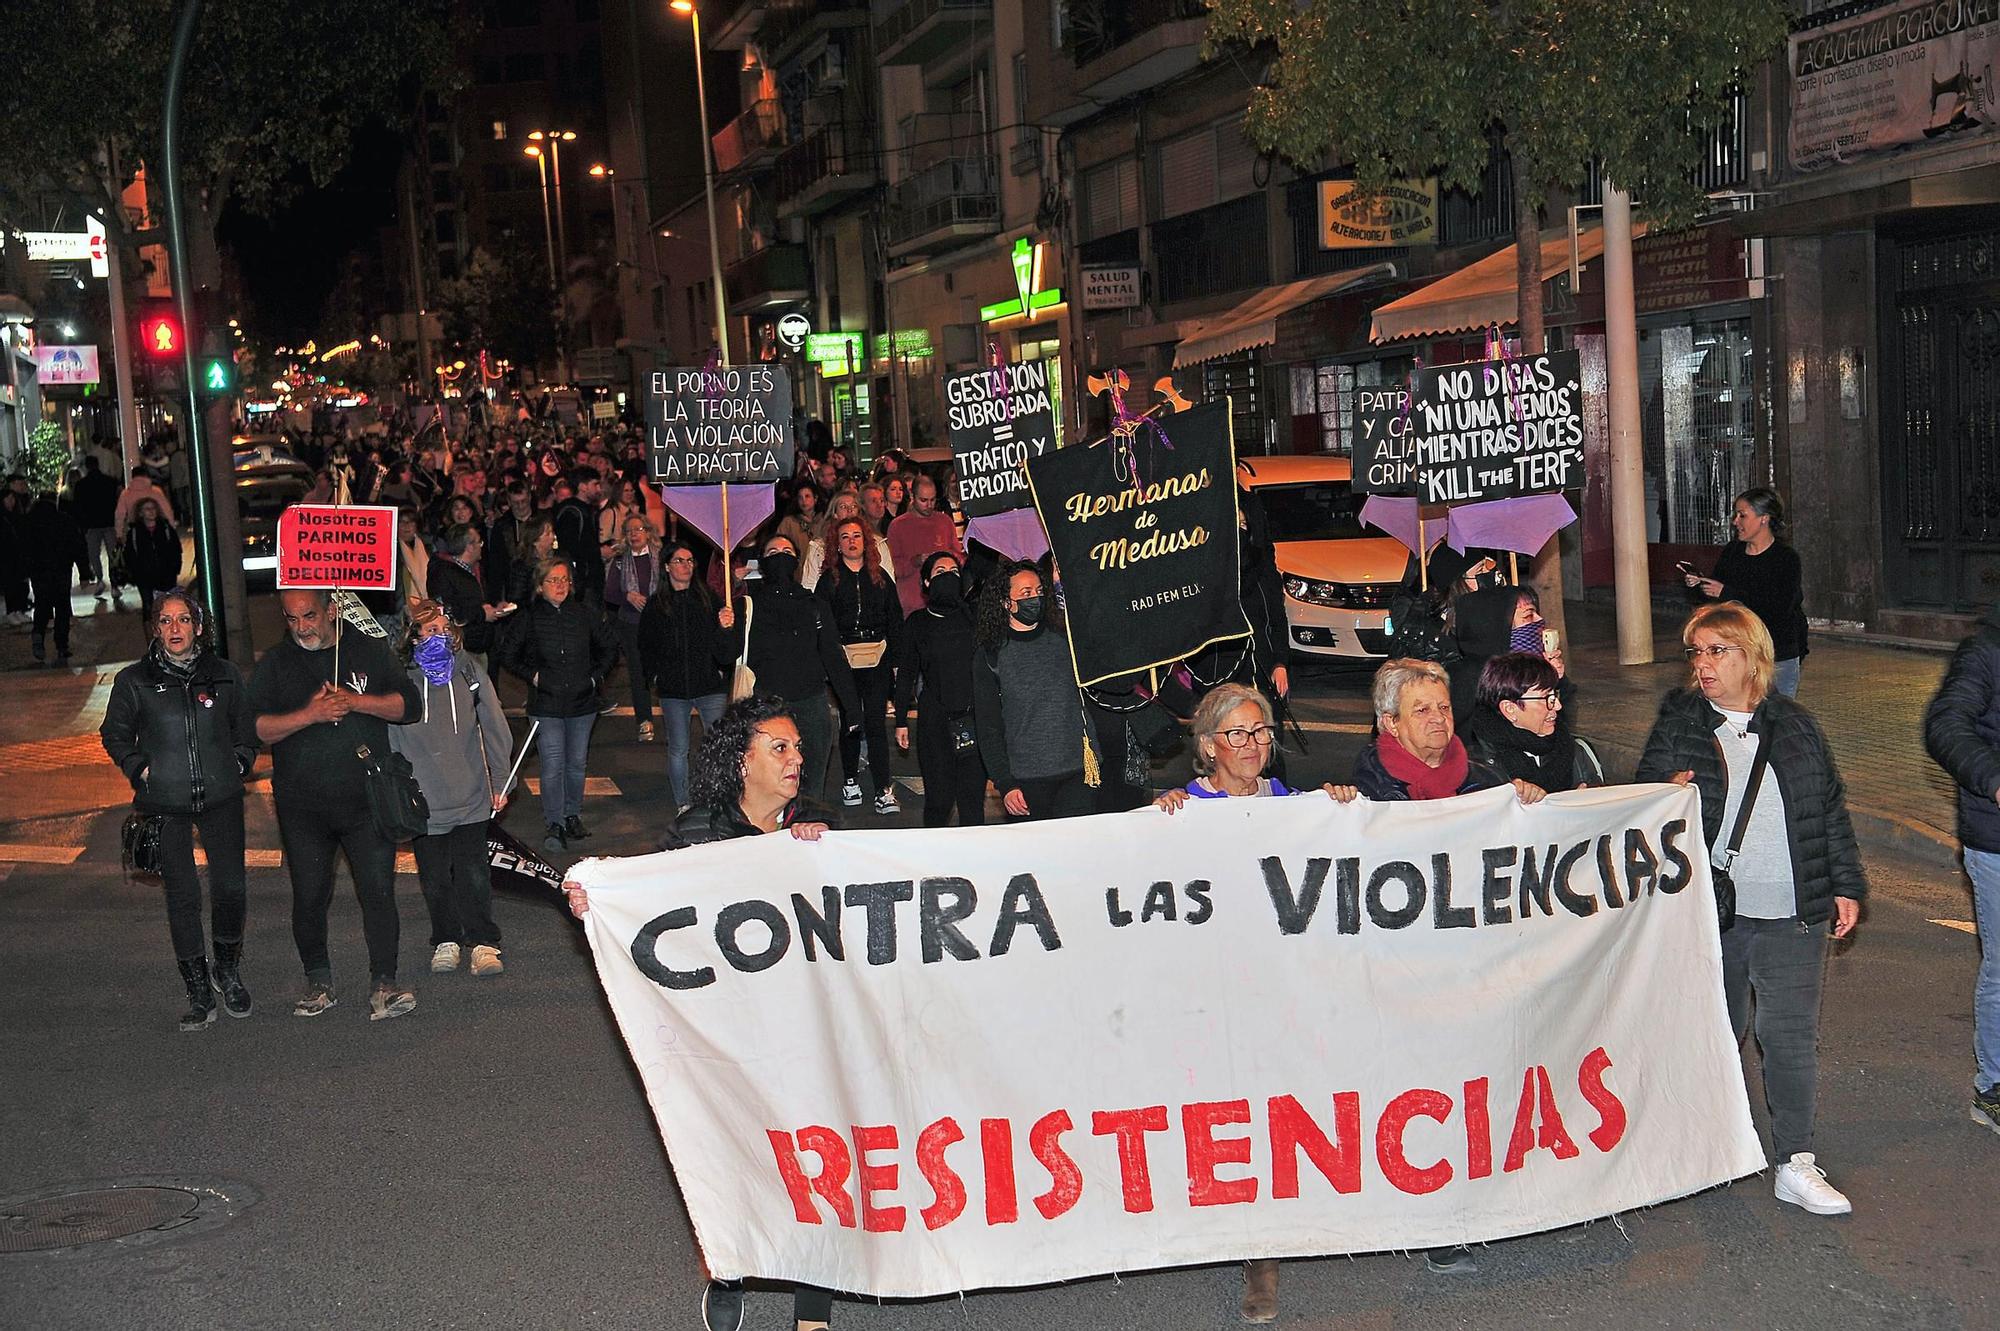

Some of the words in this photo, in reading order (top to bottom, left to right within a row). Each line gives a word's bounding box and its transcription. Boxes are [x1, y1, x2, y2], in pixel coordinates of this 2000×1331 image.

[1801, 18, 1892, 74] ACADEMIA
[1090, 272, 1130, 283] SALUD
[1658, 259, 1709, 277] TEXTIL
[1087, 284, 1135, 295] MENTAL
[652, 372, 674, 393] EL
[678, 370, 740, 393] PORNO
[750, 370, 774, 392] ES
[947, 360, 1045, 405] GESTACIÓN
[1438, 370, 1474, 402] NO
[1483, 357, 1555, 397] DIGAS
[663, 400, 688, 421] LA
[696, 394, 765, 419] TEORÍA
[949, 390, 1051, 431] SUBROGADA
[1455, 398, 1501, 430] UNA
[653, 426, 679, 448] LA
[1363, 418, 1376, 439] Y
[1416, 424, 1522, 465] MIENTRAS
[1523, 414, 1583, 451] DICES
[655, 455, 680, 476] LA
[956, 441, 1028, 476] TRÁFICO
[1032, 437, 1046, 457] Y
[1065, 468, 1213, 523] Hermanas
[299, 512, 377, 527] Nosotras
[1135, 510, 1158, 529] de
[297, 530, 377, 545] PARIMOS
[1089, 526, 1210, 570] Medusa
[298, 549, 377, 563] Nosotras
[288, 567, 385, 581] DECIDIMOS
[1131, 596, 1154, 612] RAD
[1157, 589, 1180, 605] FEM
[1182, 583, 1201, 598] ELX
[631, 873, 1062, 990] CONTRA
[1106, 879, 1213, 928] LAS
[1258, 819, 1693, 936] VIOLENCIAS
[765, 1047, 1628, 1234] RESISTENCIAS
